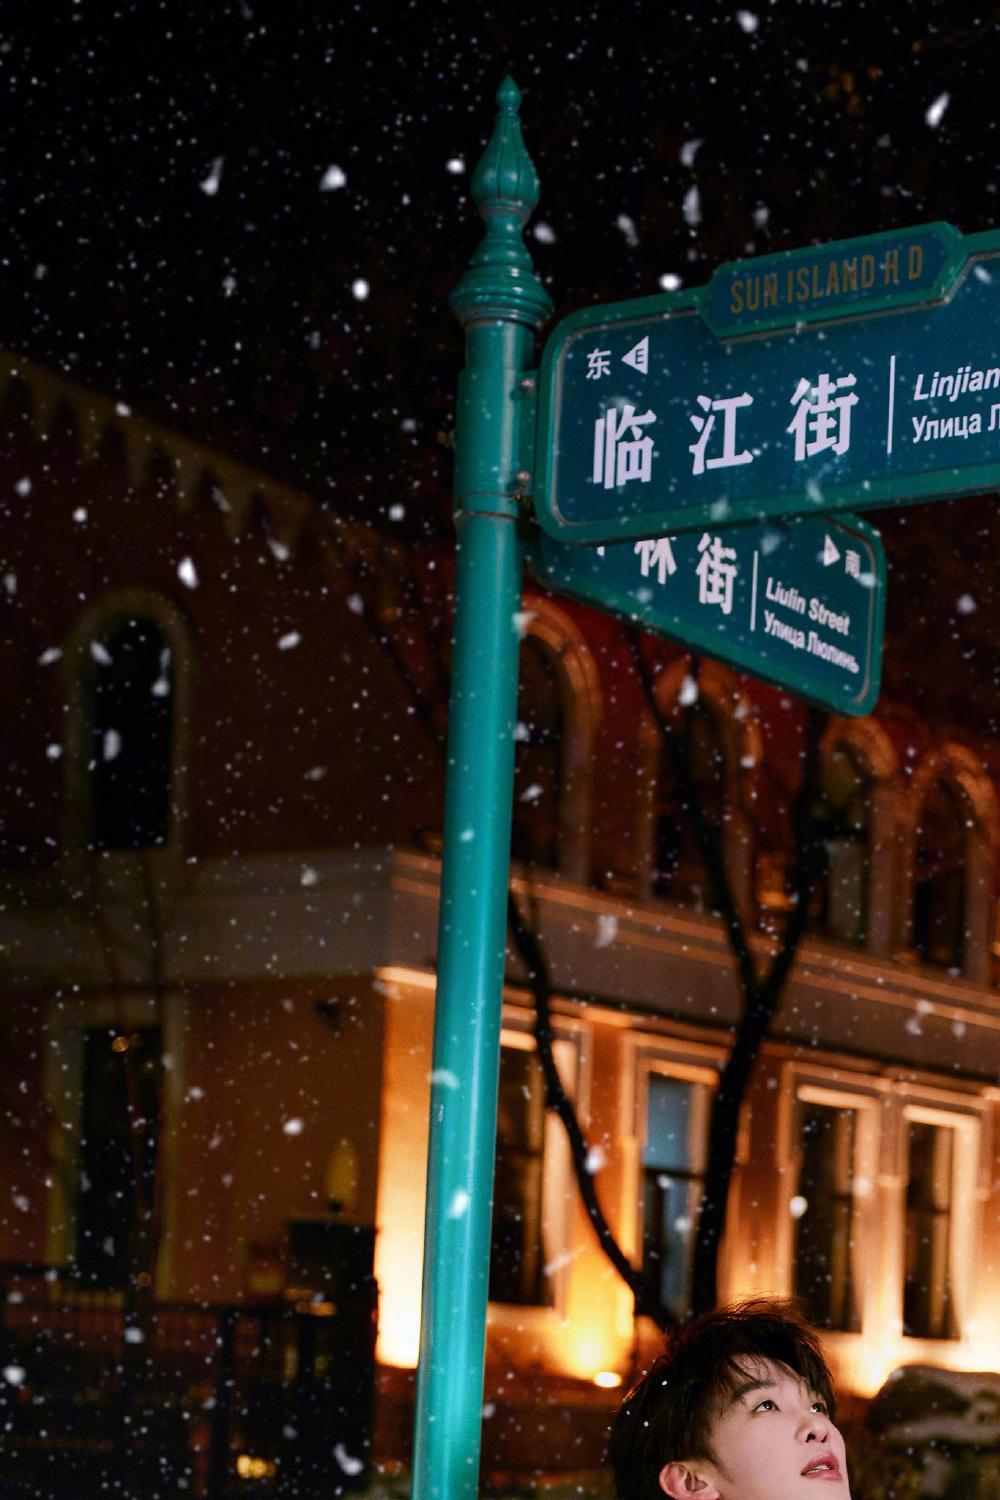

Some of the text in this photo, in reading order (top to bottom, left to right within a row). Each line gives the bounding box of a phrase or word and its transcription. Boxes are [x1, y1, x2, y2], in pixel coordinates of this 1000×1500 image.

[730, 273, 778, 314] SUN
[786, 255, 875, 304] ISLAND
[586, 349, 611, 380] 东
[635, 349, 645, 365] E
[592, 372, 860, 490] 临江街
[912, 413, 982, 443] Улица
[596, 532, 738, 615] 林街
[763, 609, 806, 650] Улица
[765, 577, 850, 636] Liulin Street
